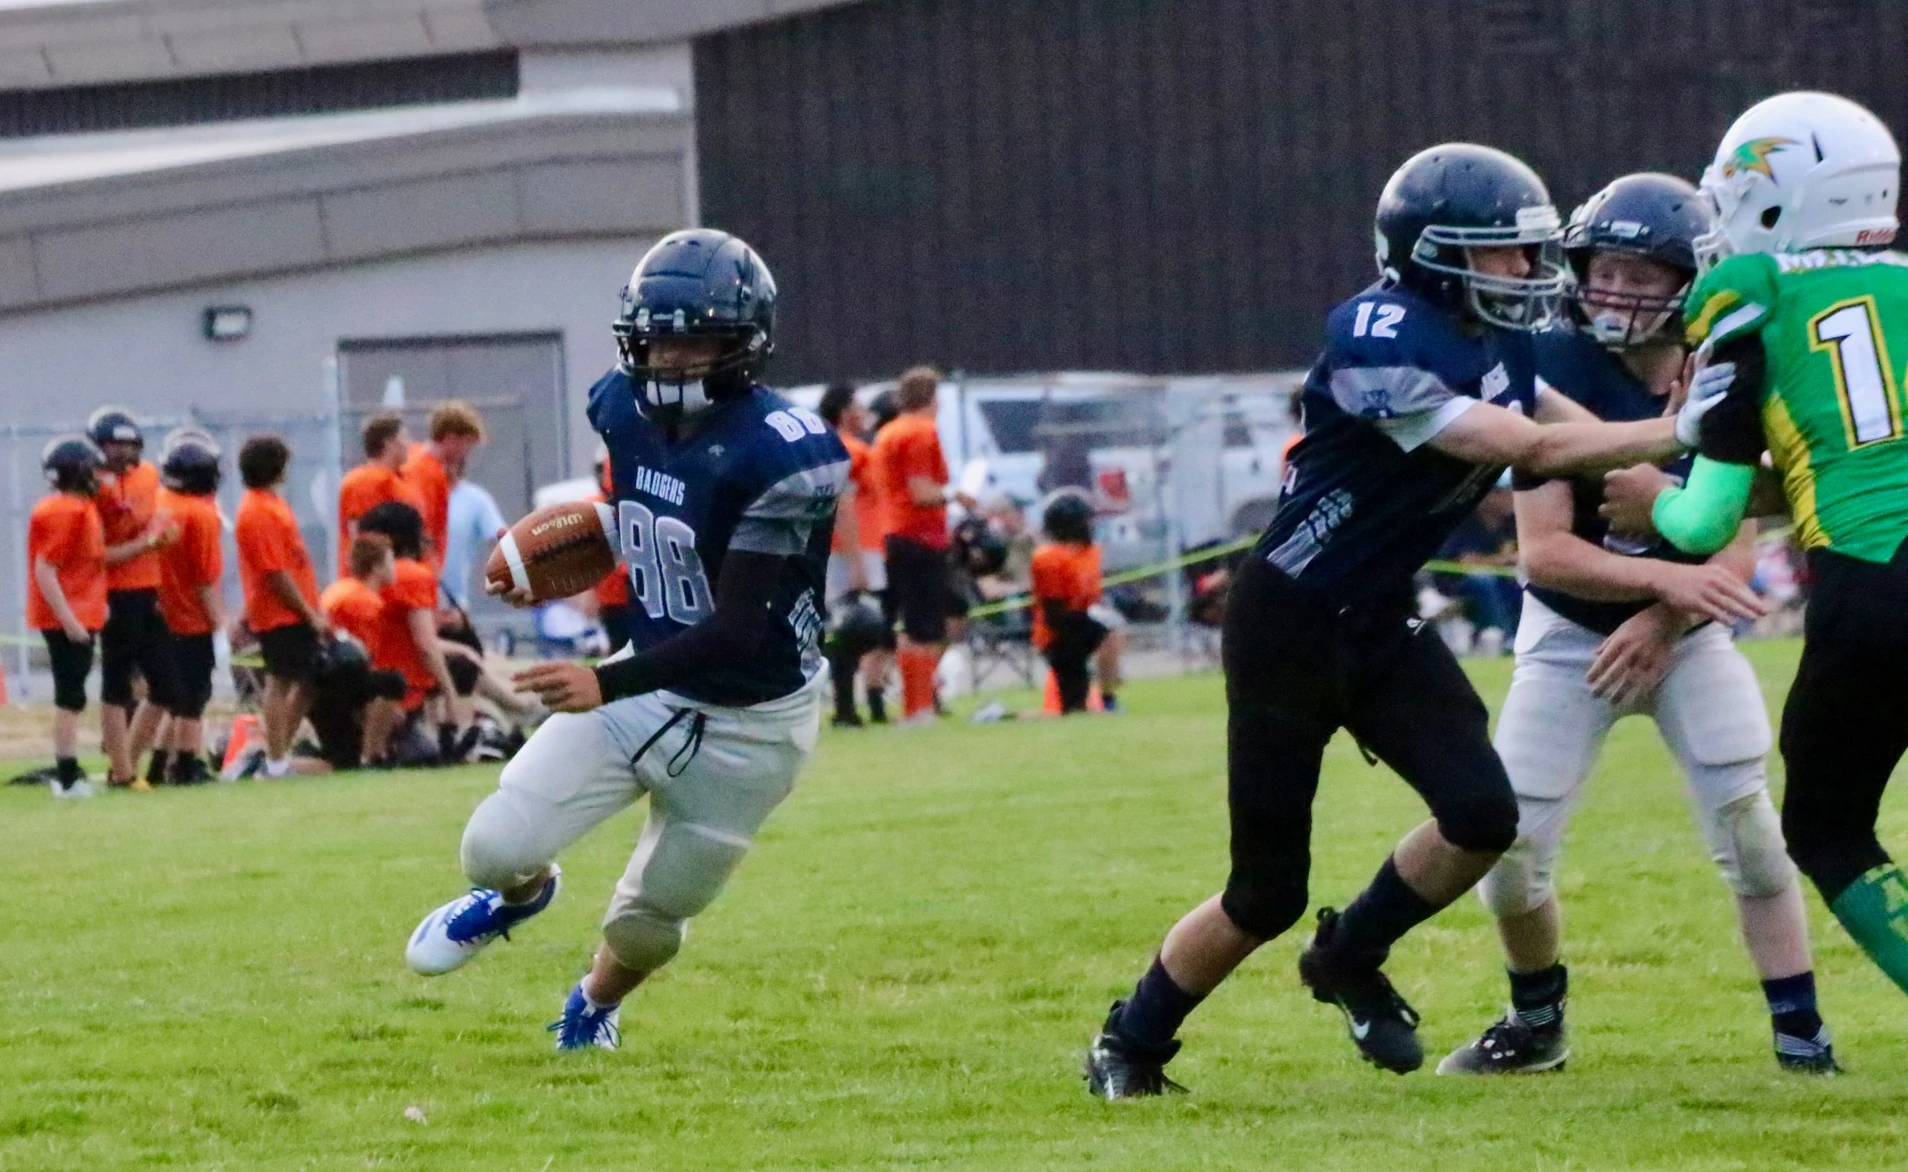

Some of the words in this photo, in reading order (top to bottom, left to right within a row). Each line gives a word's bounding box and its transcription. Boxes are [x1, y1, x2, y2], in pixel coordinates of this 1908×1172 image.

[1353, 302, 1406, 339] 12
[635, 465, 686, 506] BADGERS
[531, 513, 584, 536] Wilson
[618, 500, 716, 626] 88
